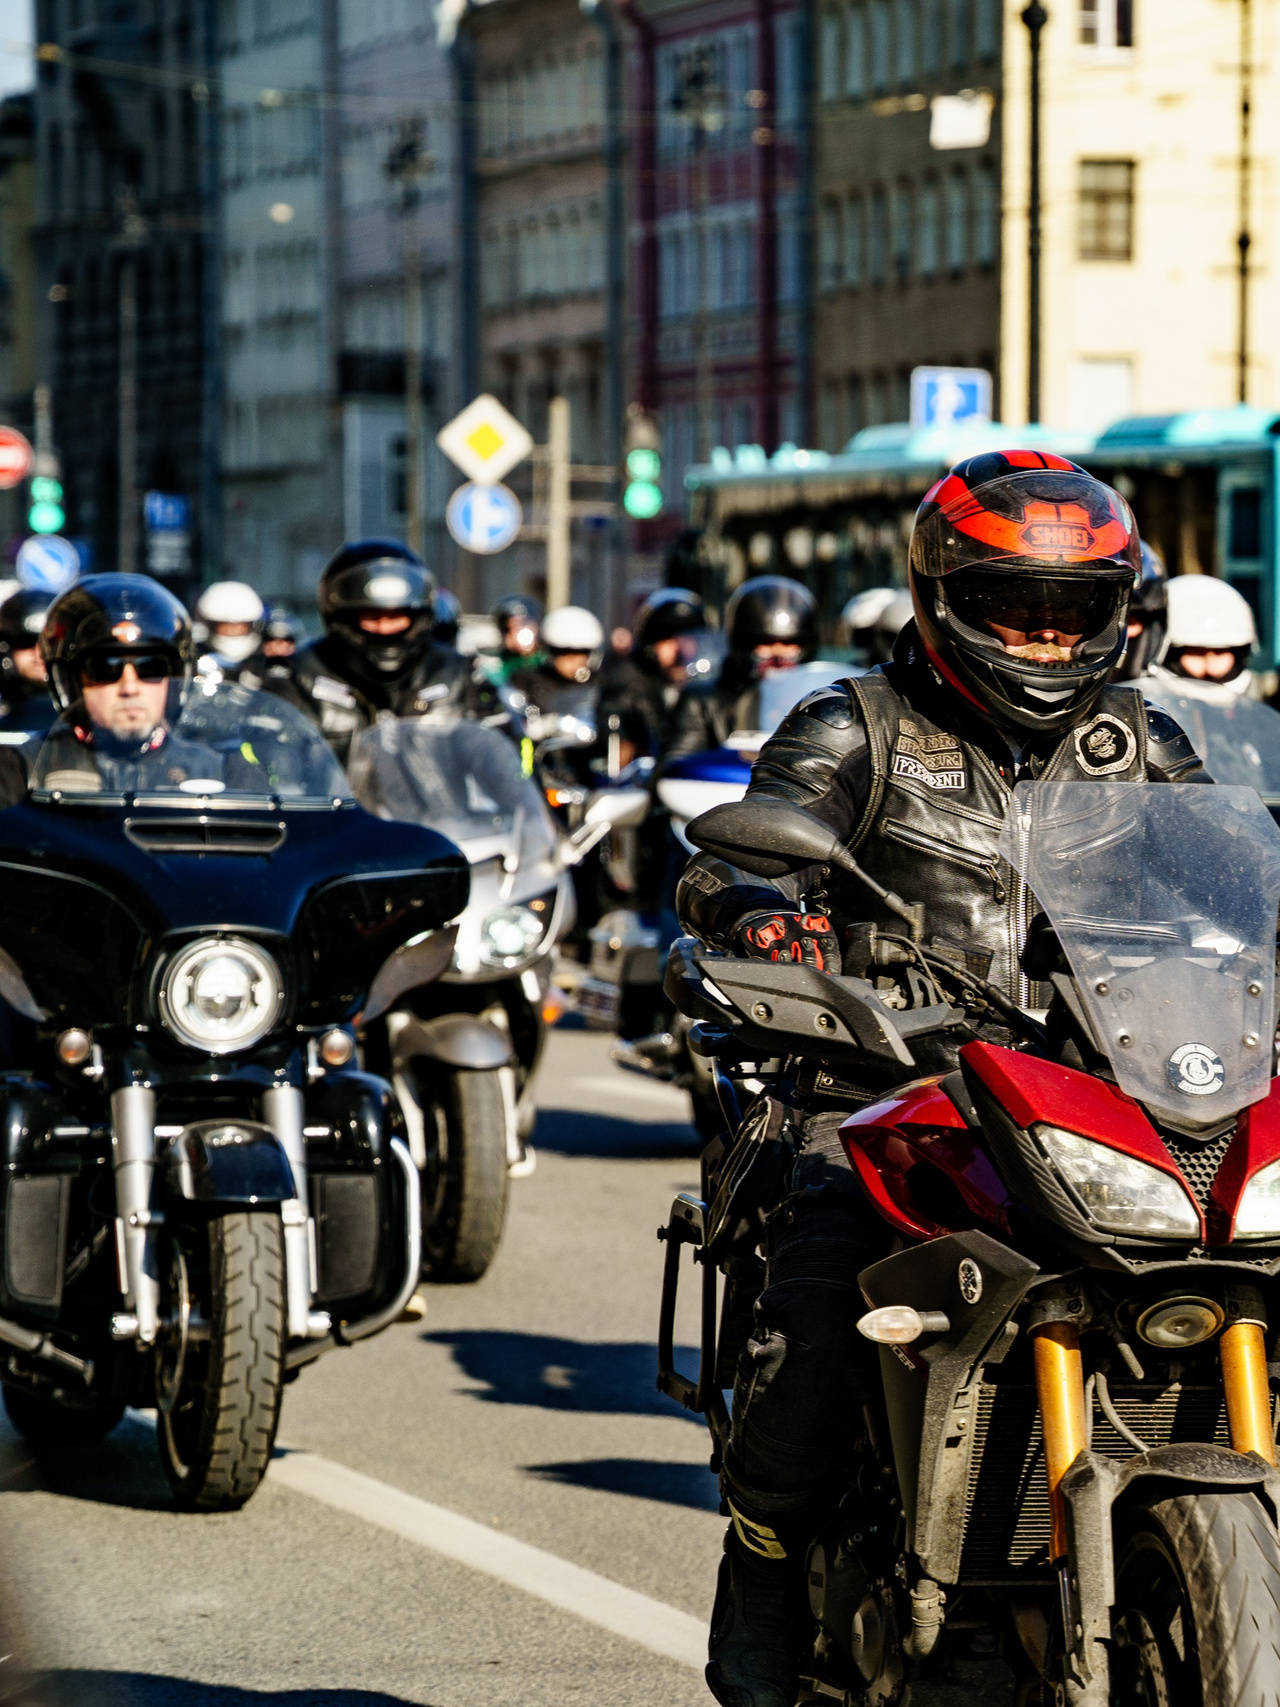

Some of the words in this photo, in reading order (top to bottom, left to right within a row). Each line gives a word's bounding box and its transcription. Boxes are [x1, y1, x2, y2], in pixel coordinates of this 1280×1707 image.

[1031, 526, 1089, 548] SHOEI
[899, 759, 960, 787] PREDENT
[889, 1344, 916, 1371] CER
